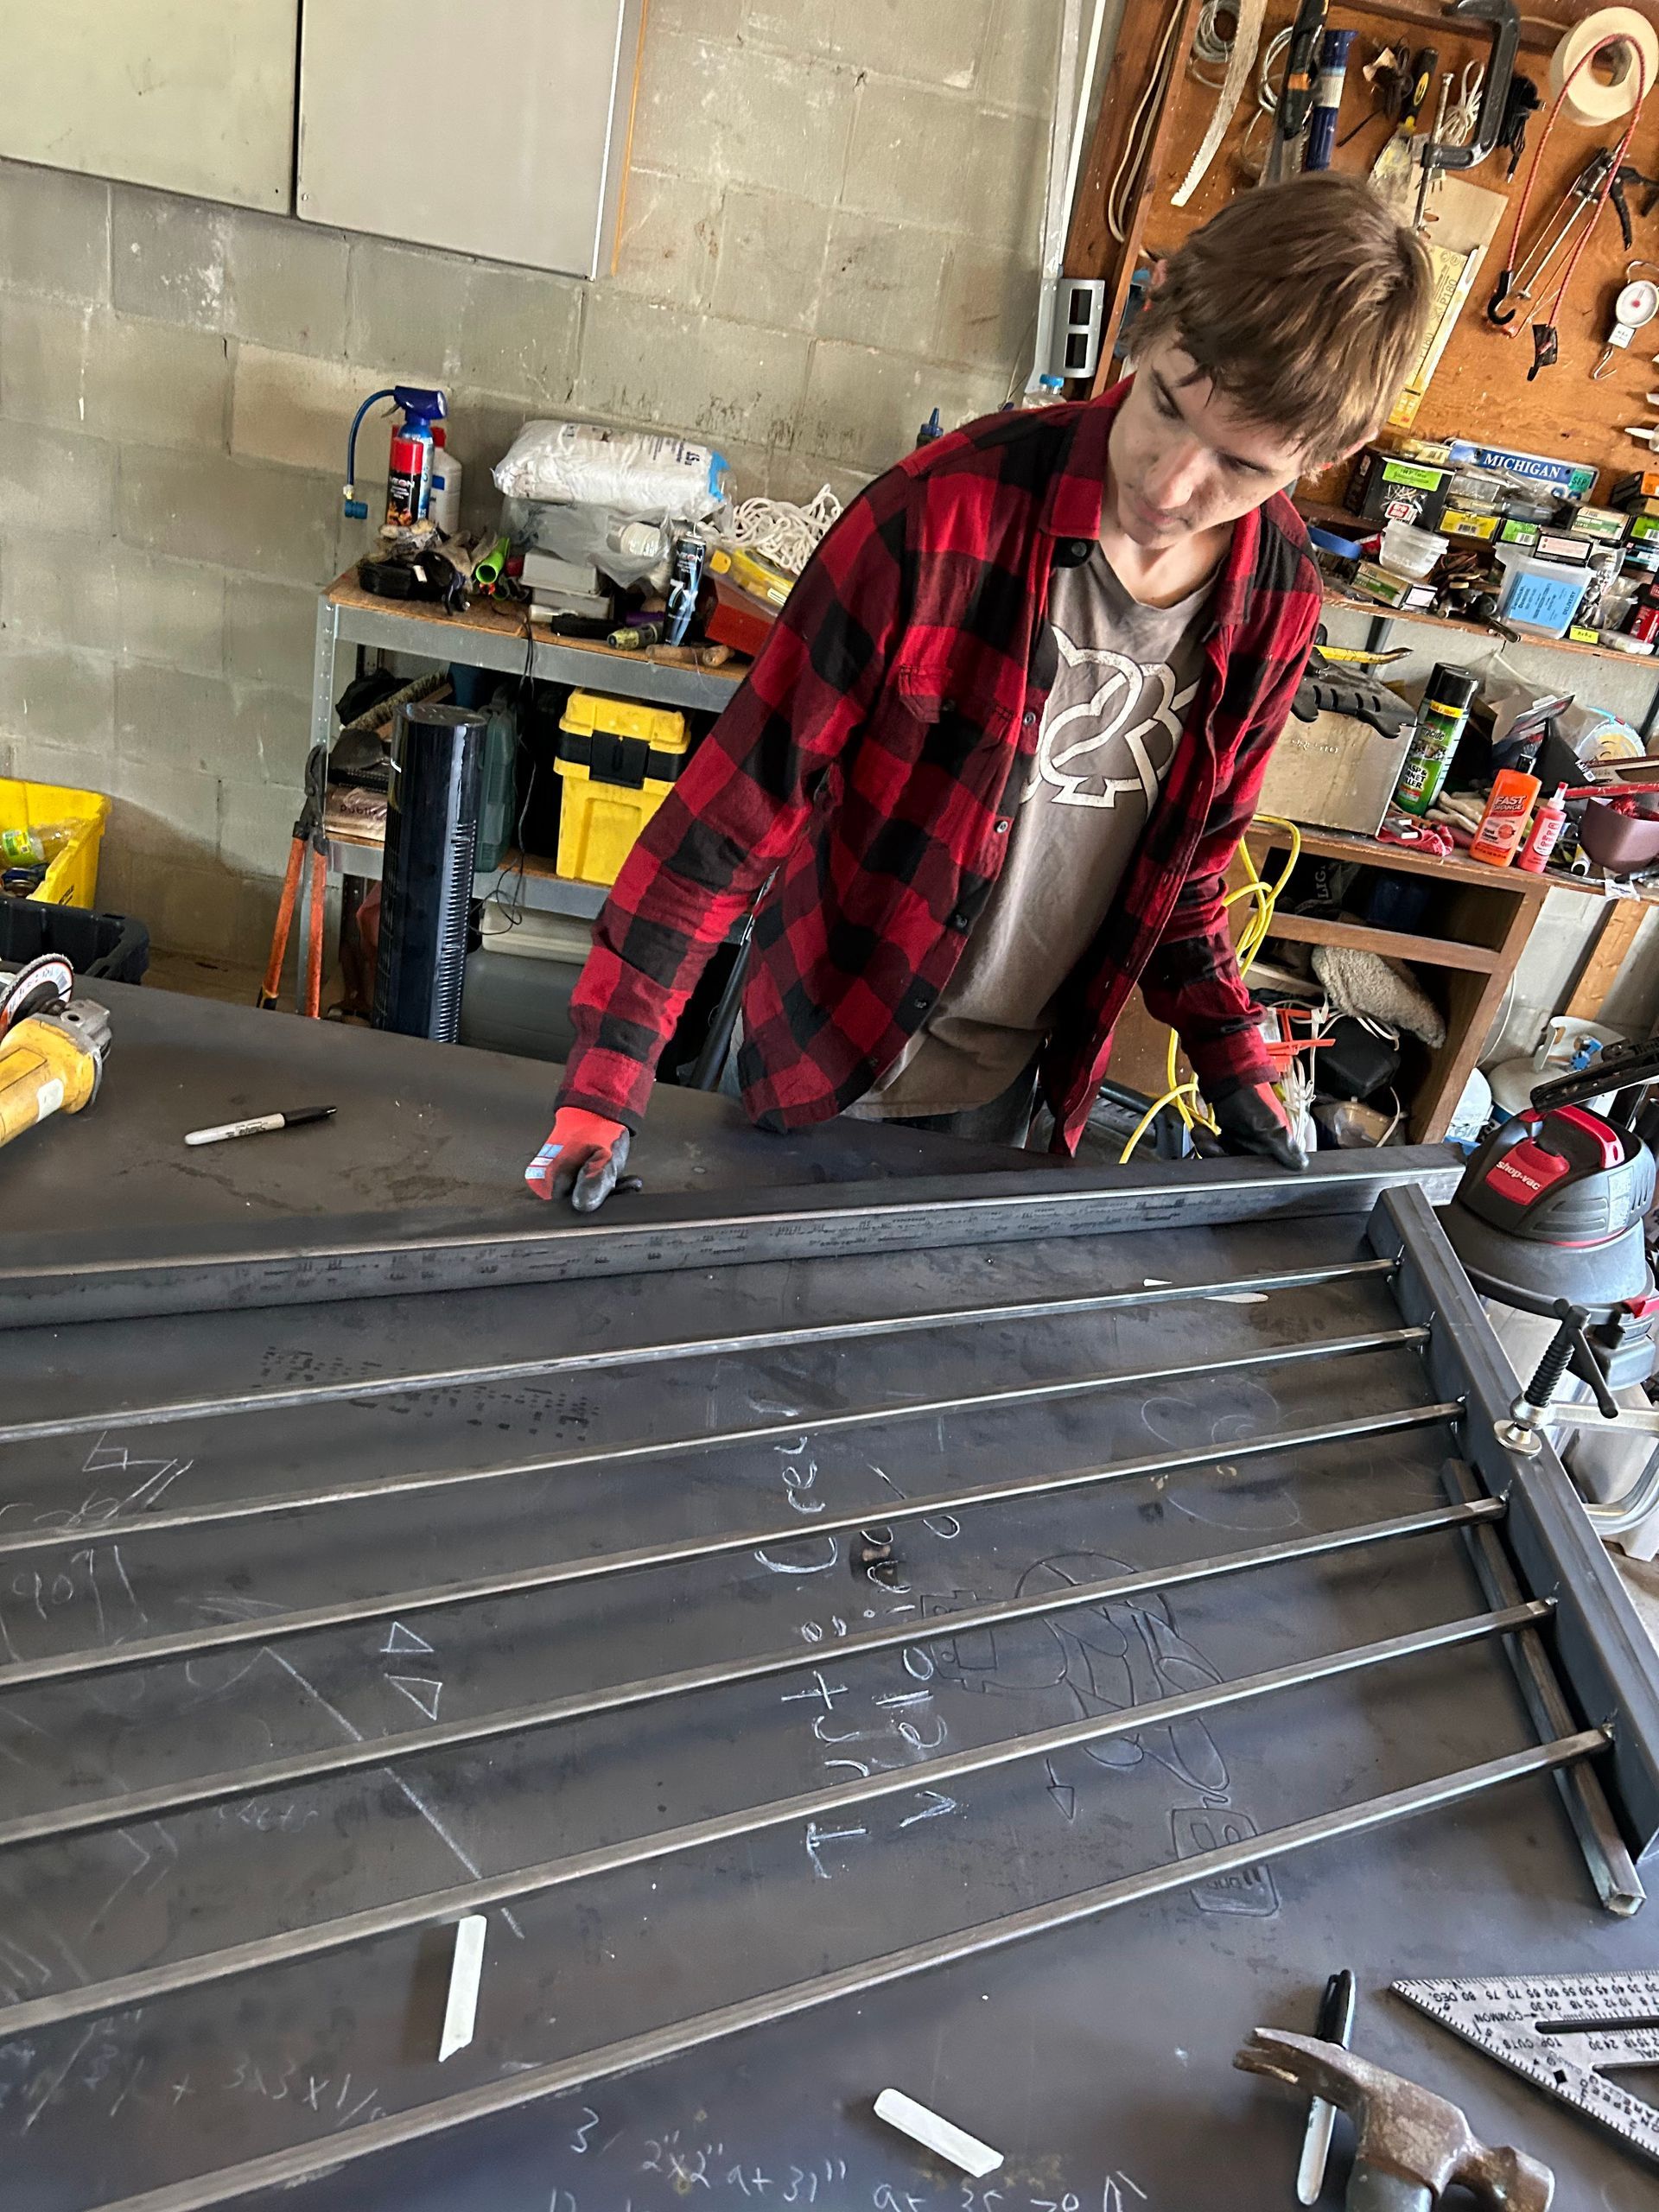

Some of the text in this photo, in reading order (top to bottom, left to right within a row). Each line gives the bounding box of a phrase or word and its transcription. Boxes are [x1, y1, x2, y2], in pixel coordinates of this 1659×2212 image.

[1440, 279, 1457, 306] P180
[1484, 454, 1561, 478] MICHIGAN
[1495, 795, 1528, 805] FAST
[1474, 2011, 1523, 2024] COMMON
[1503, 2037, 1562, 2050] TOP CUTS
